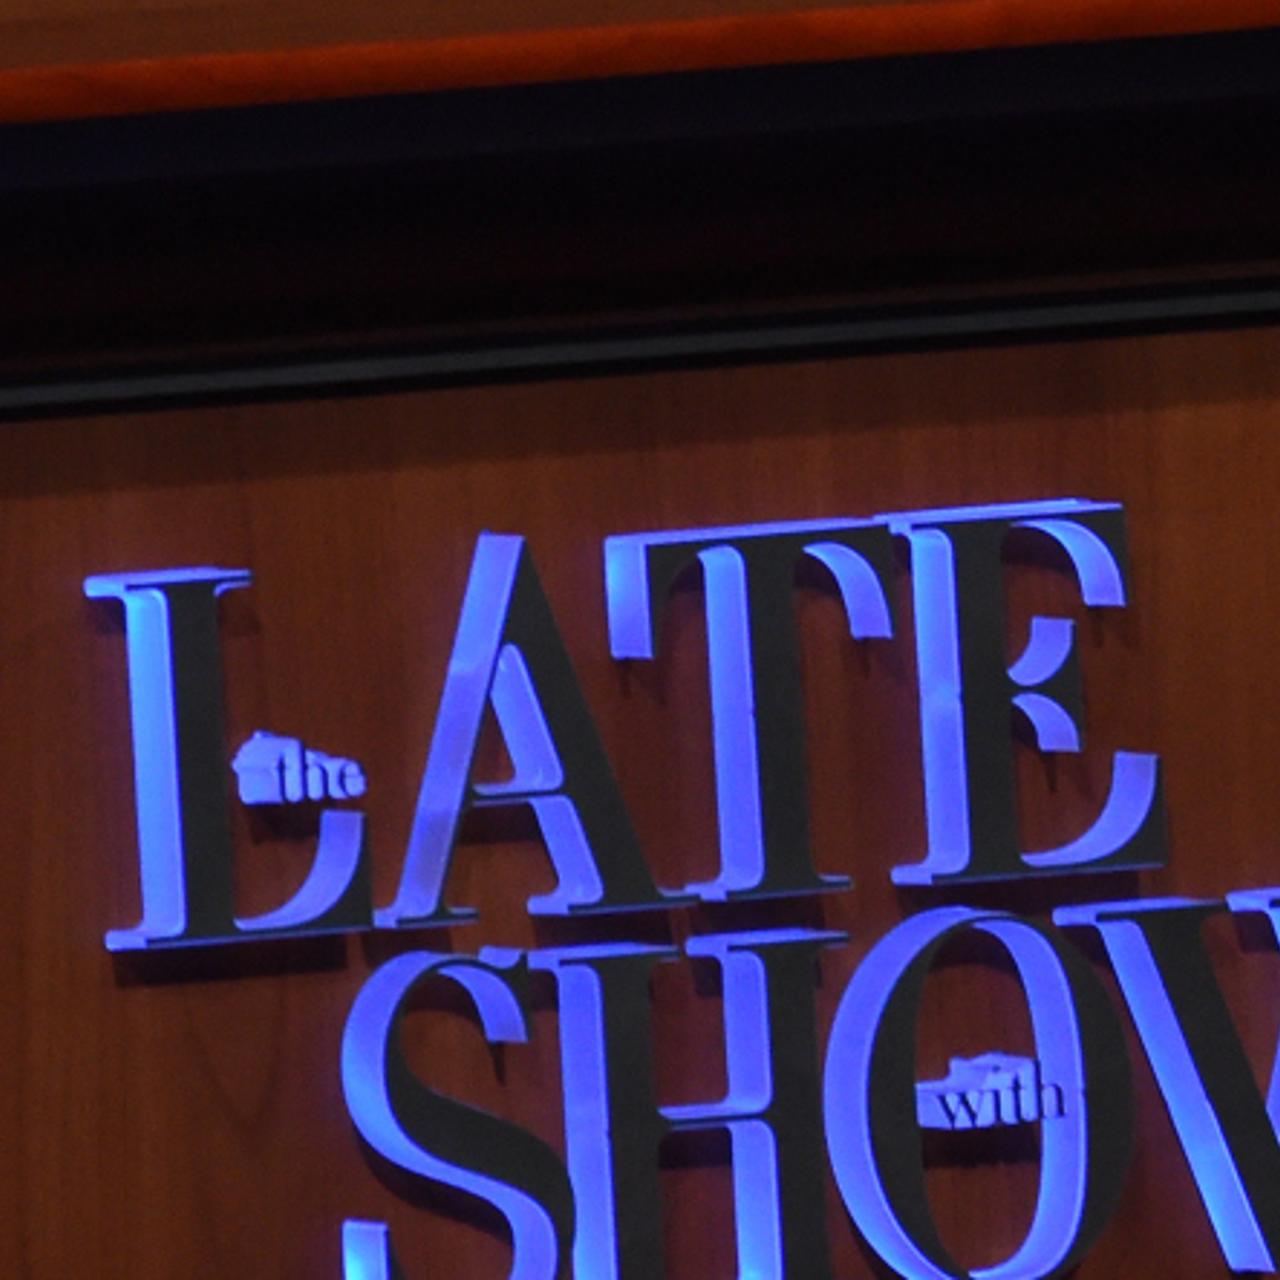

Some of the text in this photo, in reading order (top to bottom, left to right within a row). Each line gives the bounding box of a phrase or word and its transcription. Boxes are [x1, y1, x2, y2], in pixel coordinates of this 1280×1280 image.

[85, 498, 1167, 952] LATE
[238, 731, 370, 806] the
[920, 1052, 1067, 1130] with
